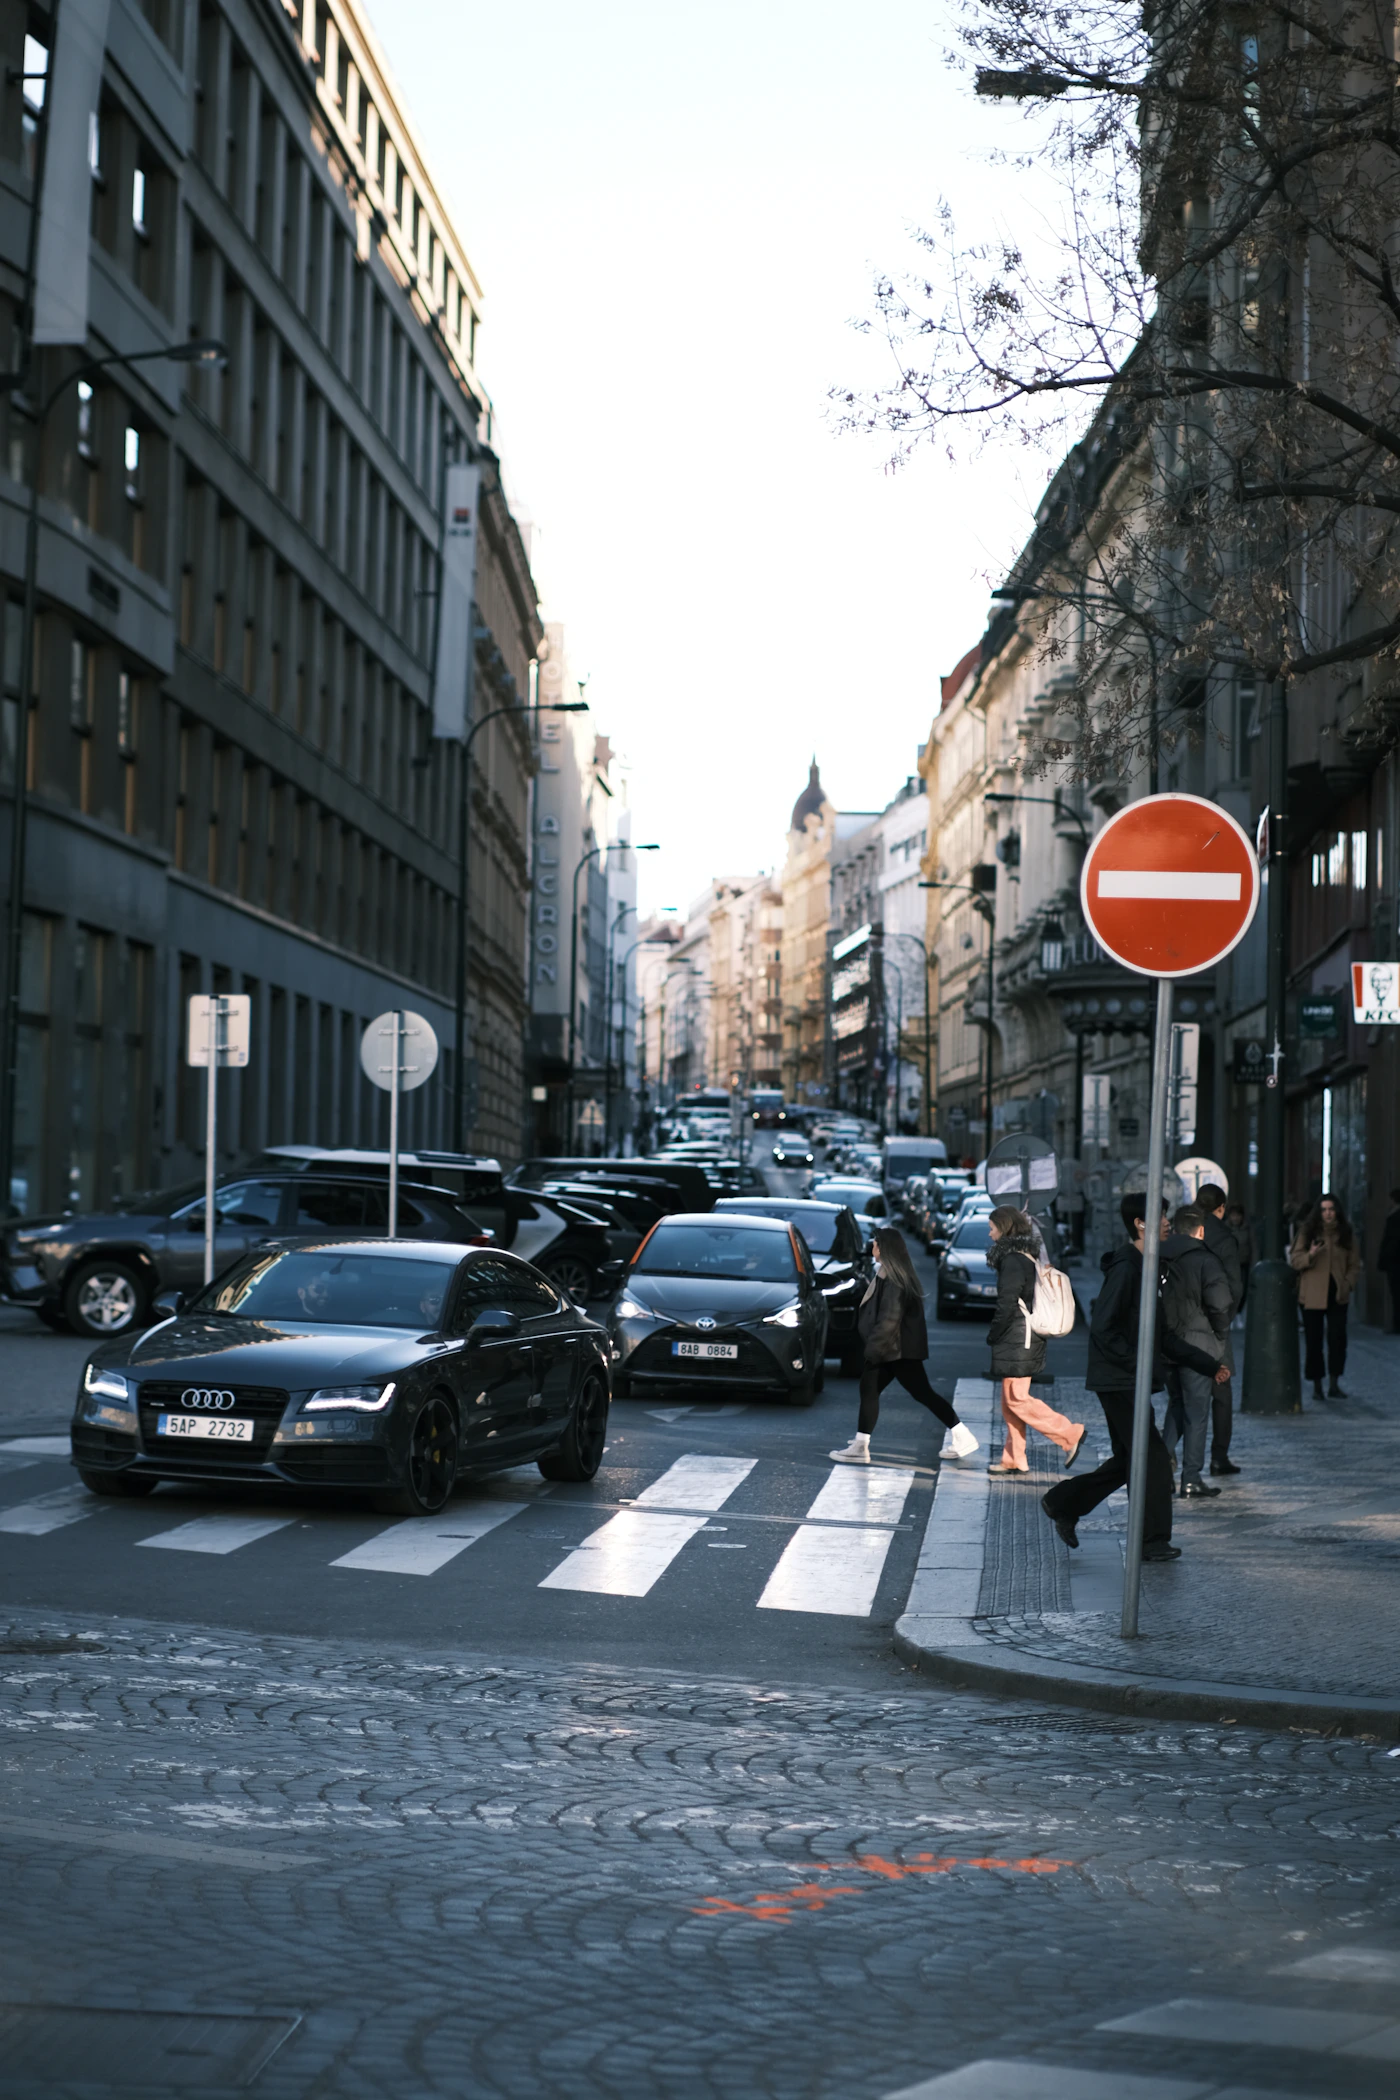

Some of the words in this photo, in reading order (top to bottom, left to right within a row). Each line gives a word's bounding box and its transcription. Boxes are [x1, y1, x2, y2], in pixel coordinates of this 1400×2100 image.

[537, 815, 559, 985] ALCRON
[1364, 1010, 1399, 1022] KFC
[681, 1344, 699, 1355] 8AB
[707, 1345, 732, 1357] 0884
[170, 1417, 196, 1434] 5AP
[208, 1420, 245, 1438] 2732
